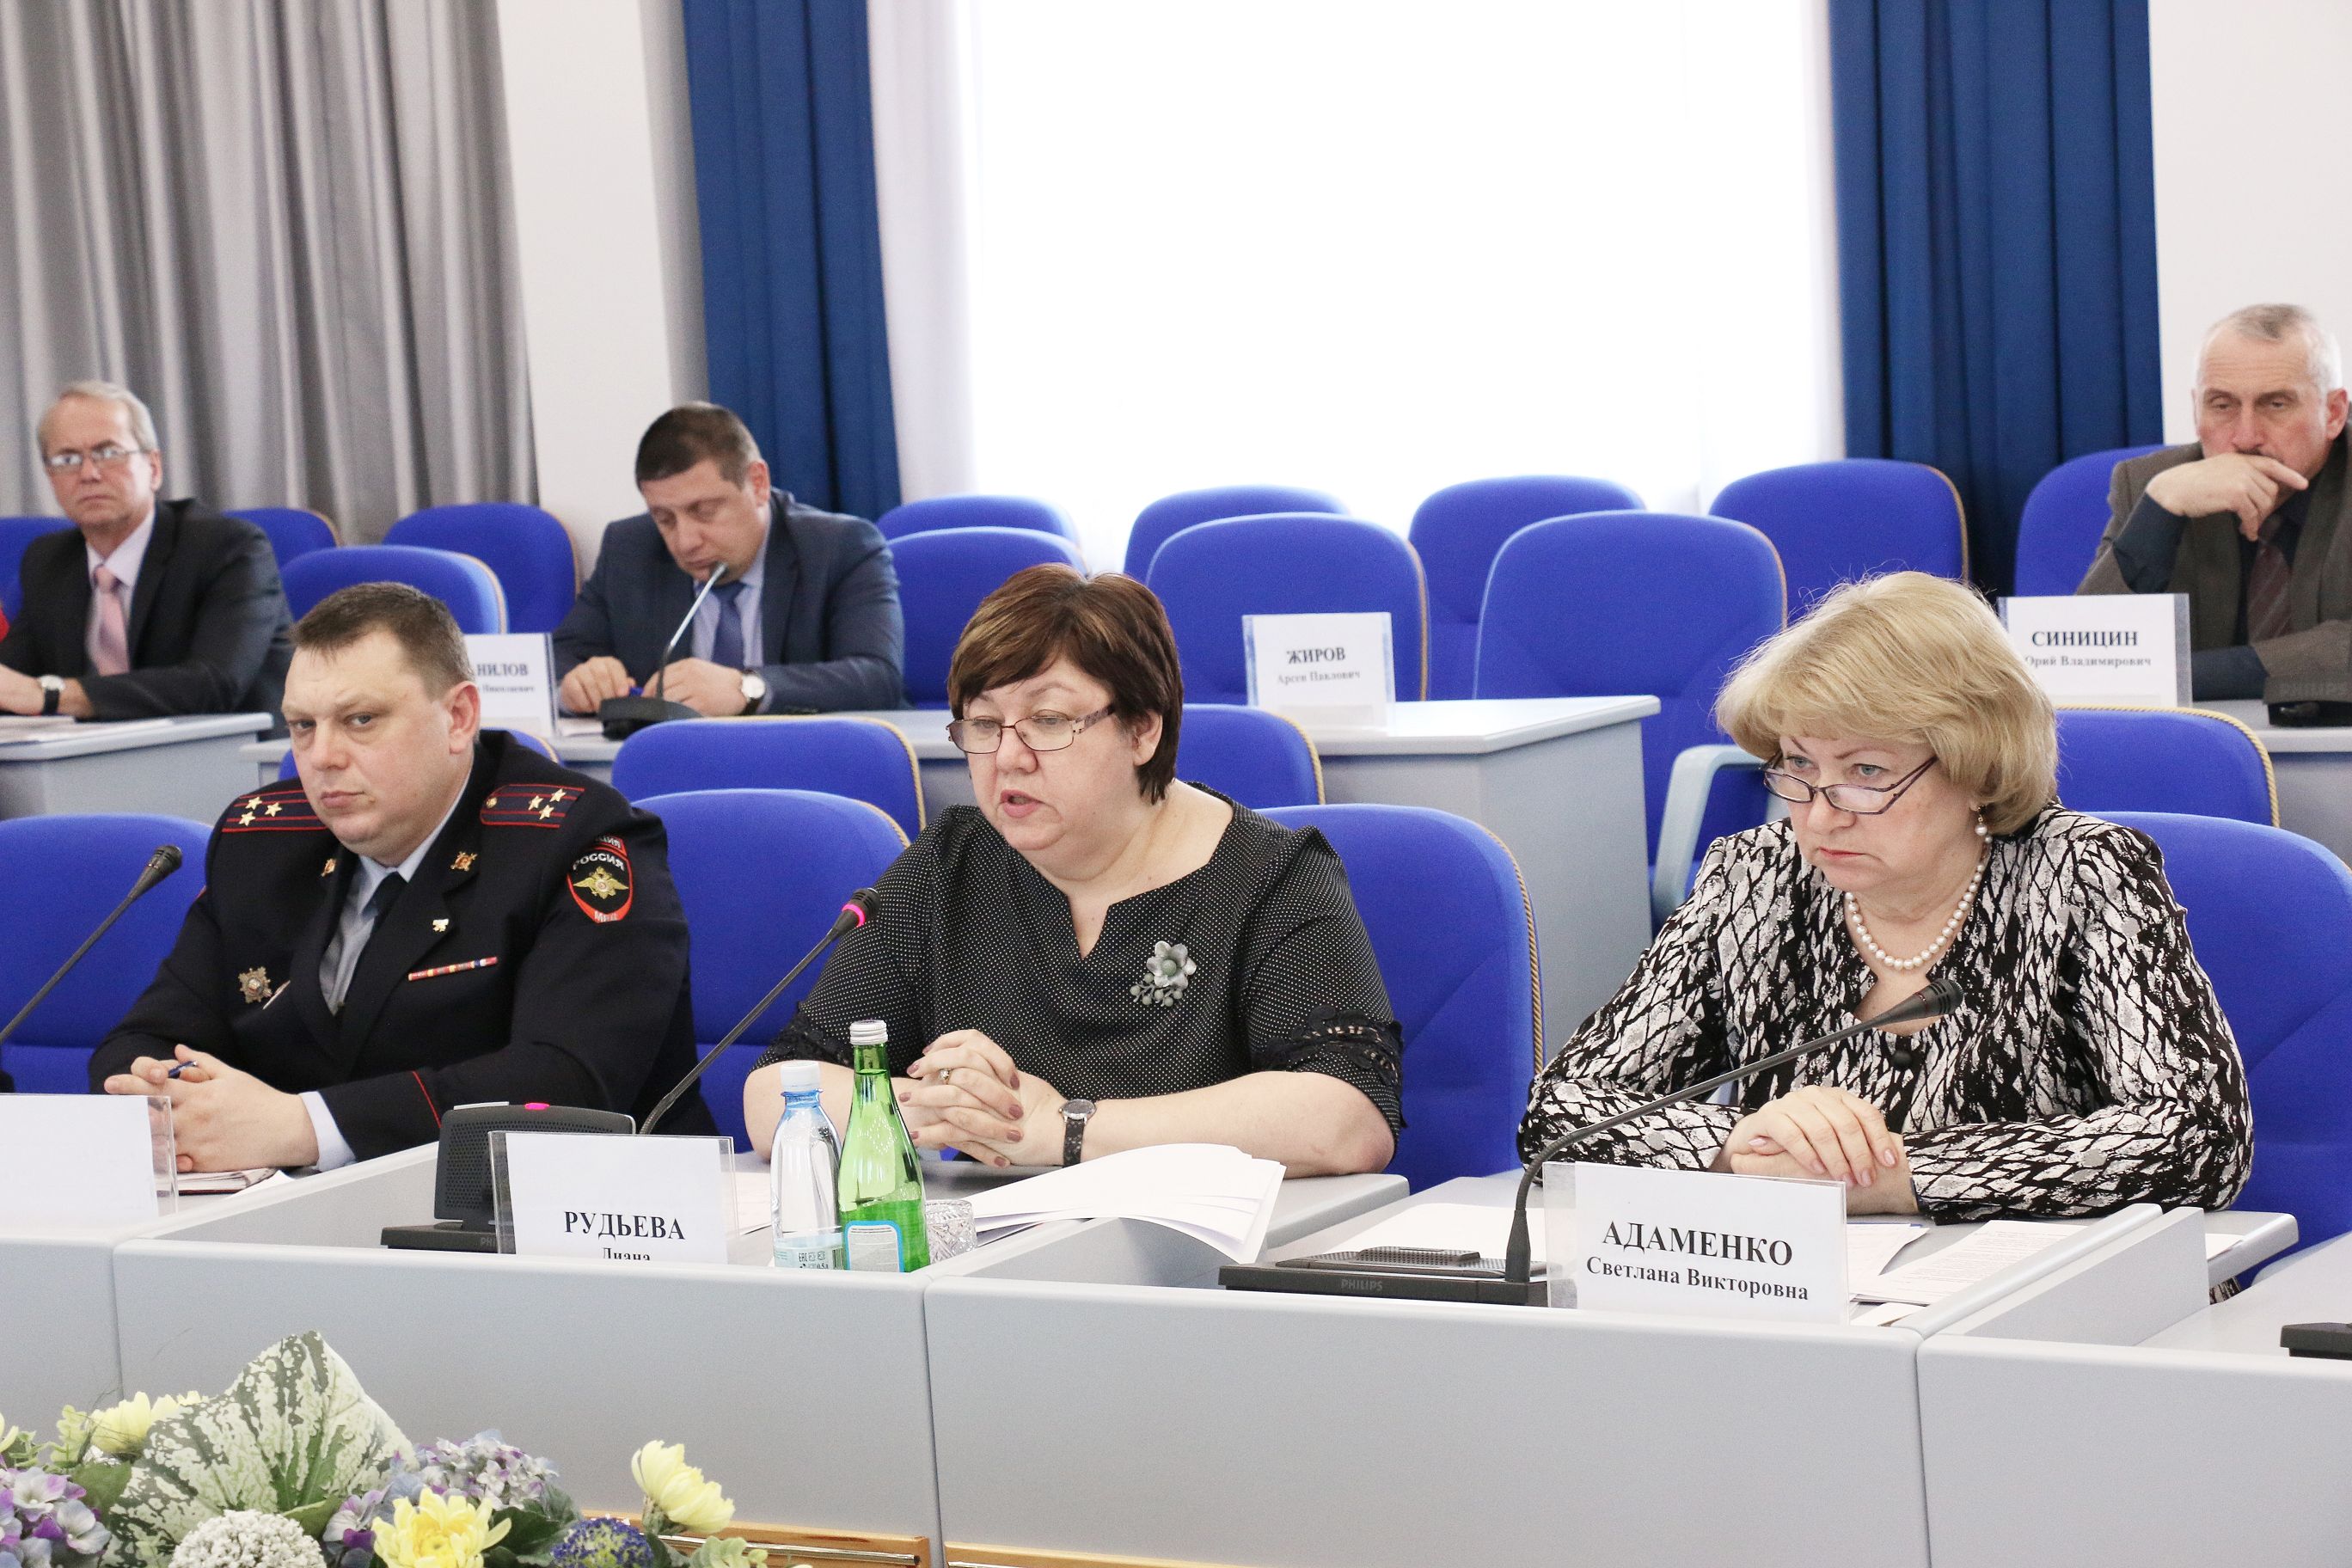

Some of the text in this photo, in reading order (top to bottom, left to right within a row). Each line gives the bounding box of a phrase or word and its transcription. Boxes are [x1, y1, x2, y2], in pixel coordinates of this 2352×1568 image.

[2031, 631, 2139, 647] СИНИЦИН
[1287, 646, 1346, 665] ЖИРОВ
[2061, 656, 2152, 669] Владимирович
[472, 663, 528, 677] НИЛОВ
[1277, 671, 1361, 686] Арсен Павлович
[564, 1211, 686, 1241] РУДЬЕВА
[1602, 1221, 1793, 1266] АДАМЕНКО
[1341, 1278, 1383, 1291] PHILIPS
[1586, 1256, 1809, 1301] Светлана Викторовна
